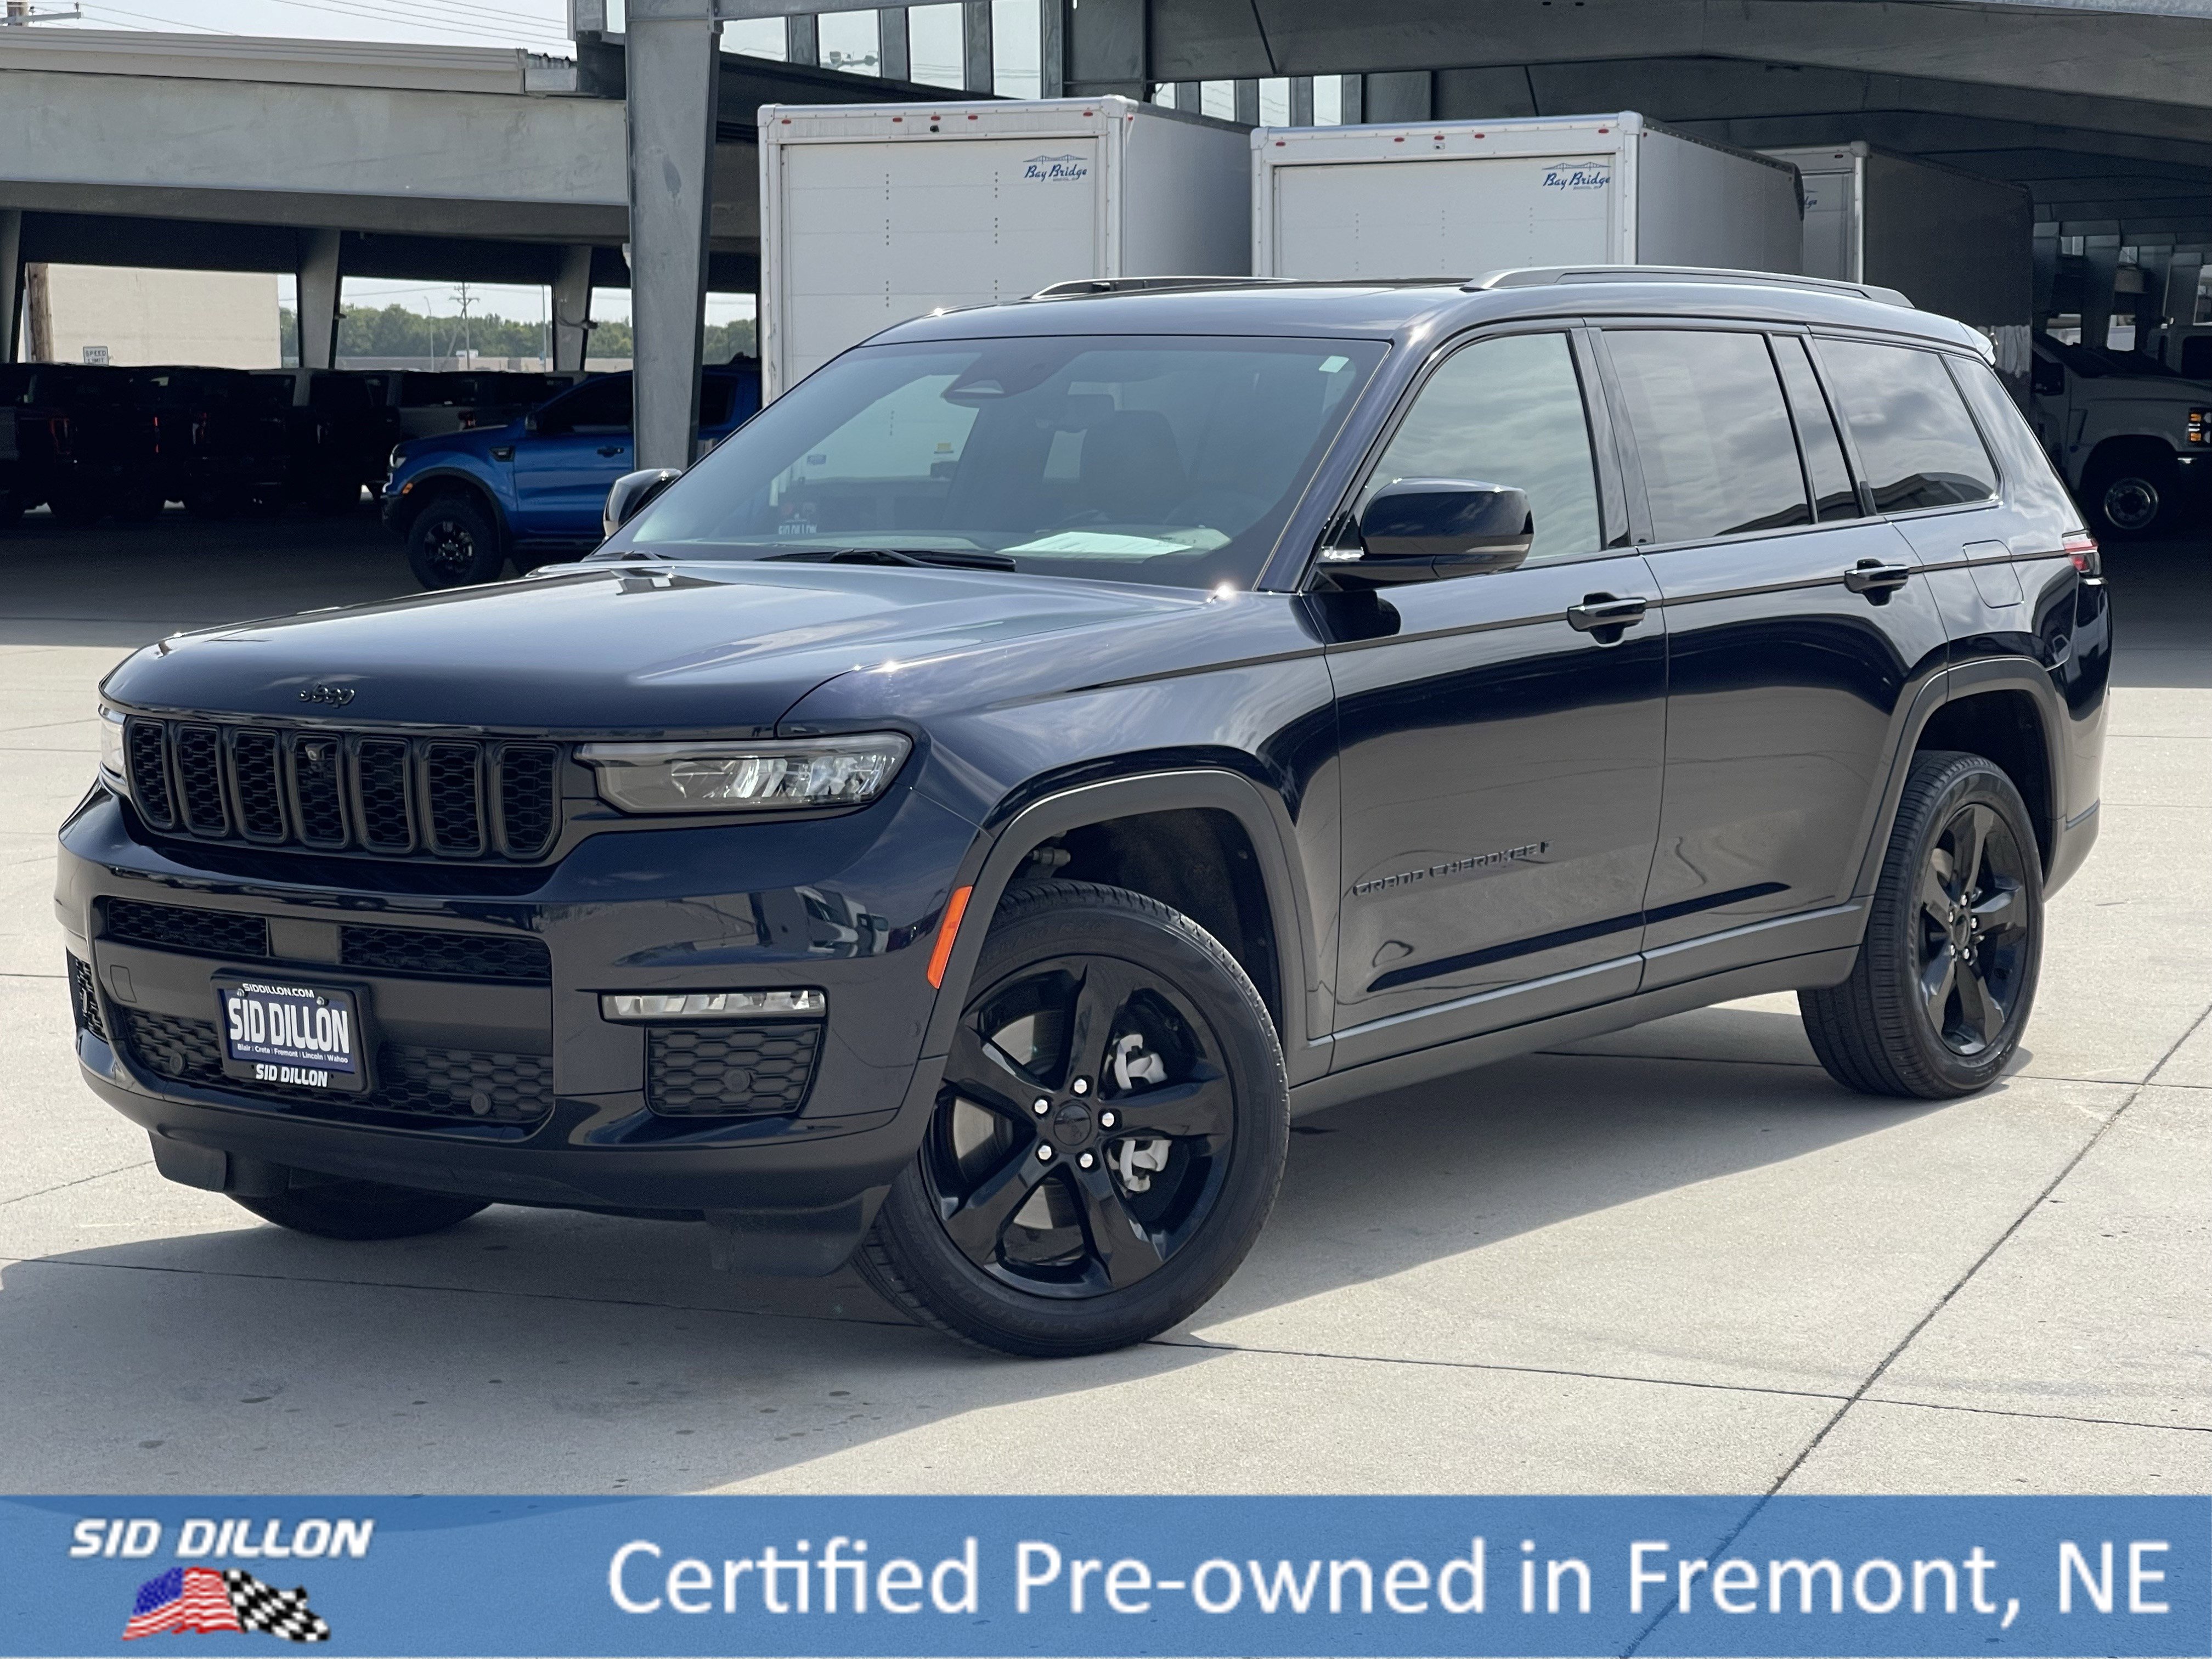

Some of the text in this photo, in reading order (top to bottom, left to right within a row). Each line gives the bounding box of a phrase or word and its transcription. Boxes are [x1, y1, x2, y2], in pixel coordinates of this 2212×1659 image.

[1024, 163, 1087, 182] Bay Bridge
[1543, 171, 1611, 190] Bay Bridge
[298, 682, 355, 708] Jeep
[1353, 870, 1425, 896] GRAND
[1429, 843, 1537, 878] CHEROKEE
[242, 983, 315, 998] SIDDILLON.COM
[228, 997, 350, 1054] SID DILLON
[237, 1043, 348, 1064] Blair Crete Fremont Lincoln Wahoo
[256, 1063, 328, 1088] SID DILLON
